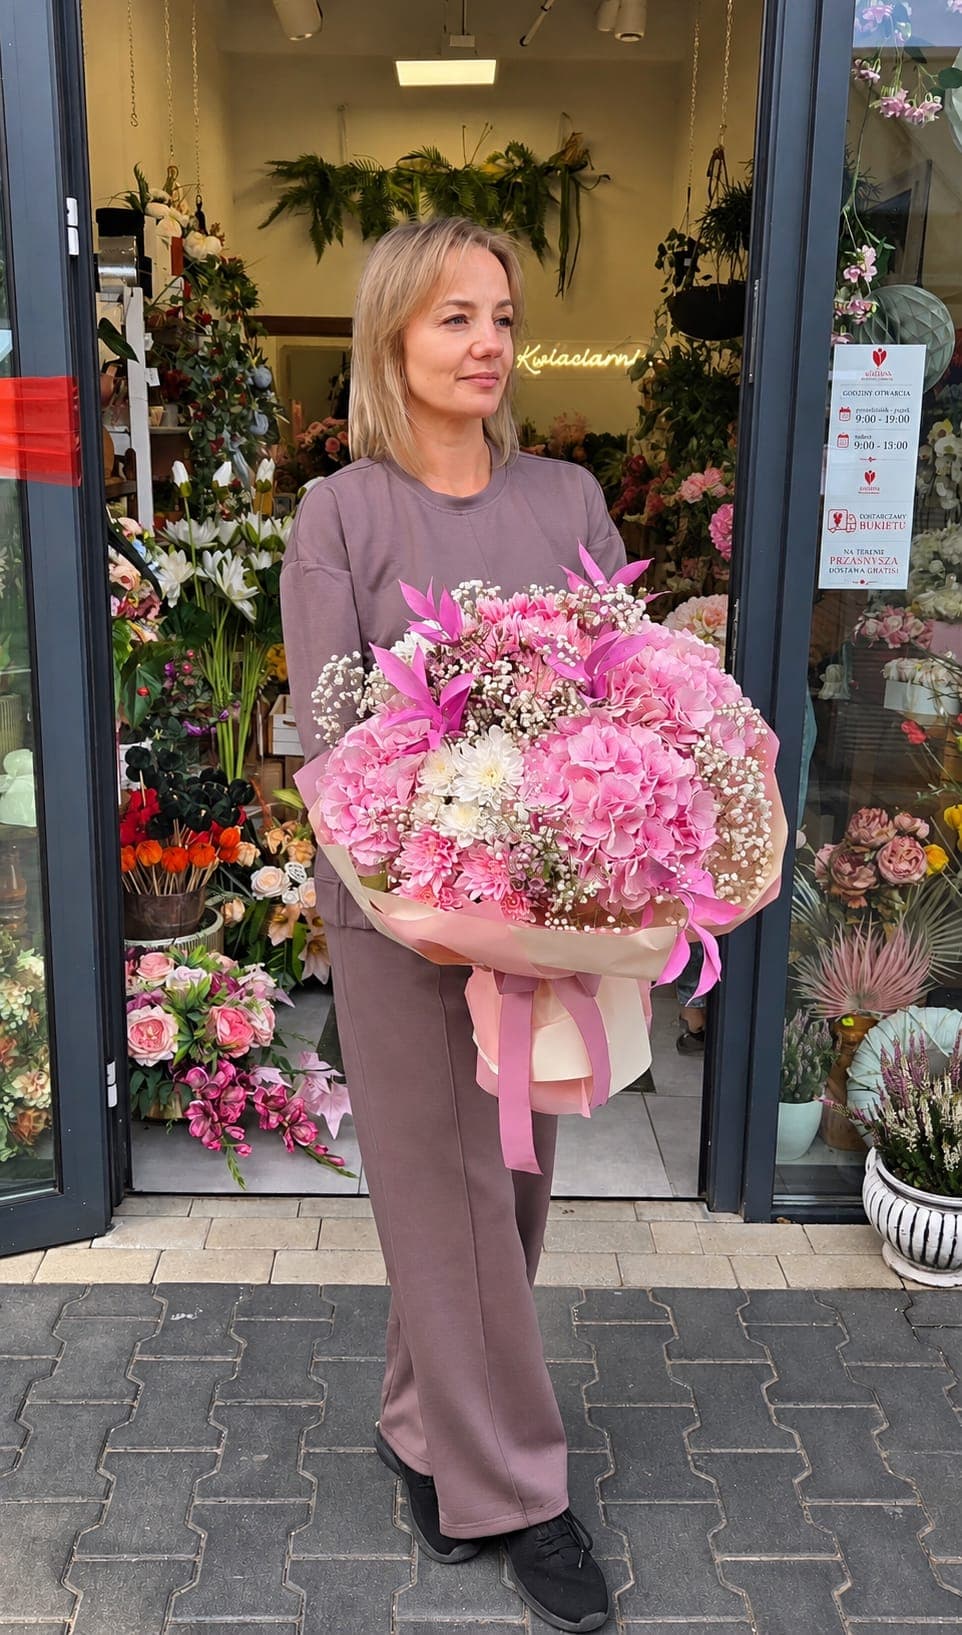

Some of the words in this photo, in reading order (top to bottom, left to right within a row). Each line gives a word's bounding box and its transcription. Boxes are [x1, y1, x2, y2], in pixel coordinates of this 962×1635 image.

[516, 344, 646, 375] Kwiaciarni
[855, 414, 876, 424] 9:00
[885, 414, 910, 424] 19:00
[854, 440, 875, 450] 9:00
[859, 521, 906, 530] BUKIETU
[830, 556, 898, 565] PRZASNYSZA
